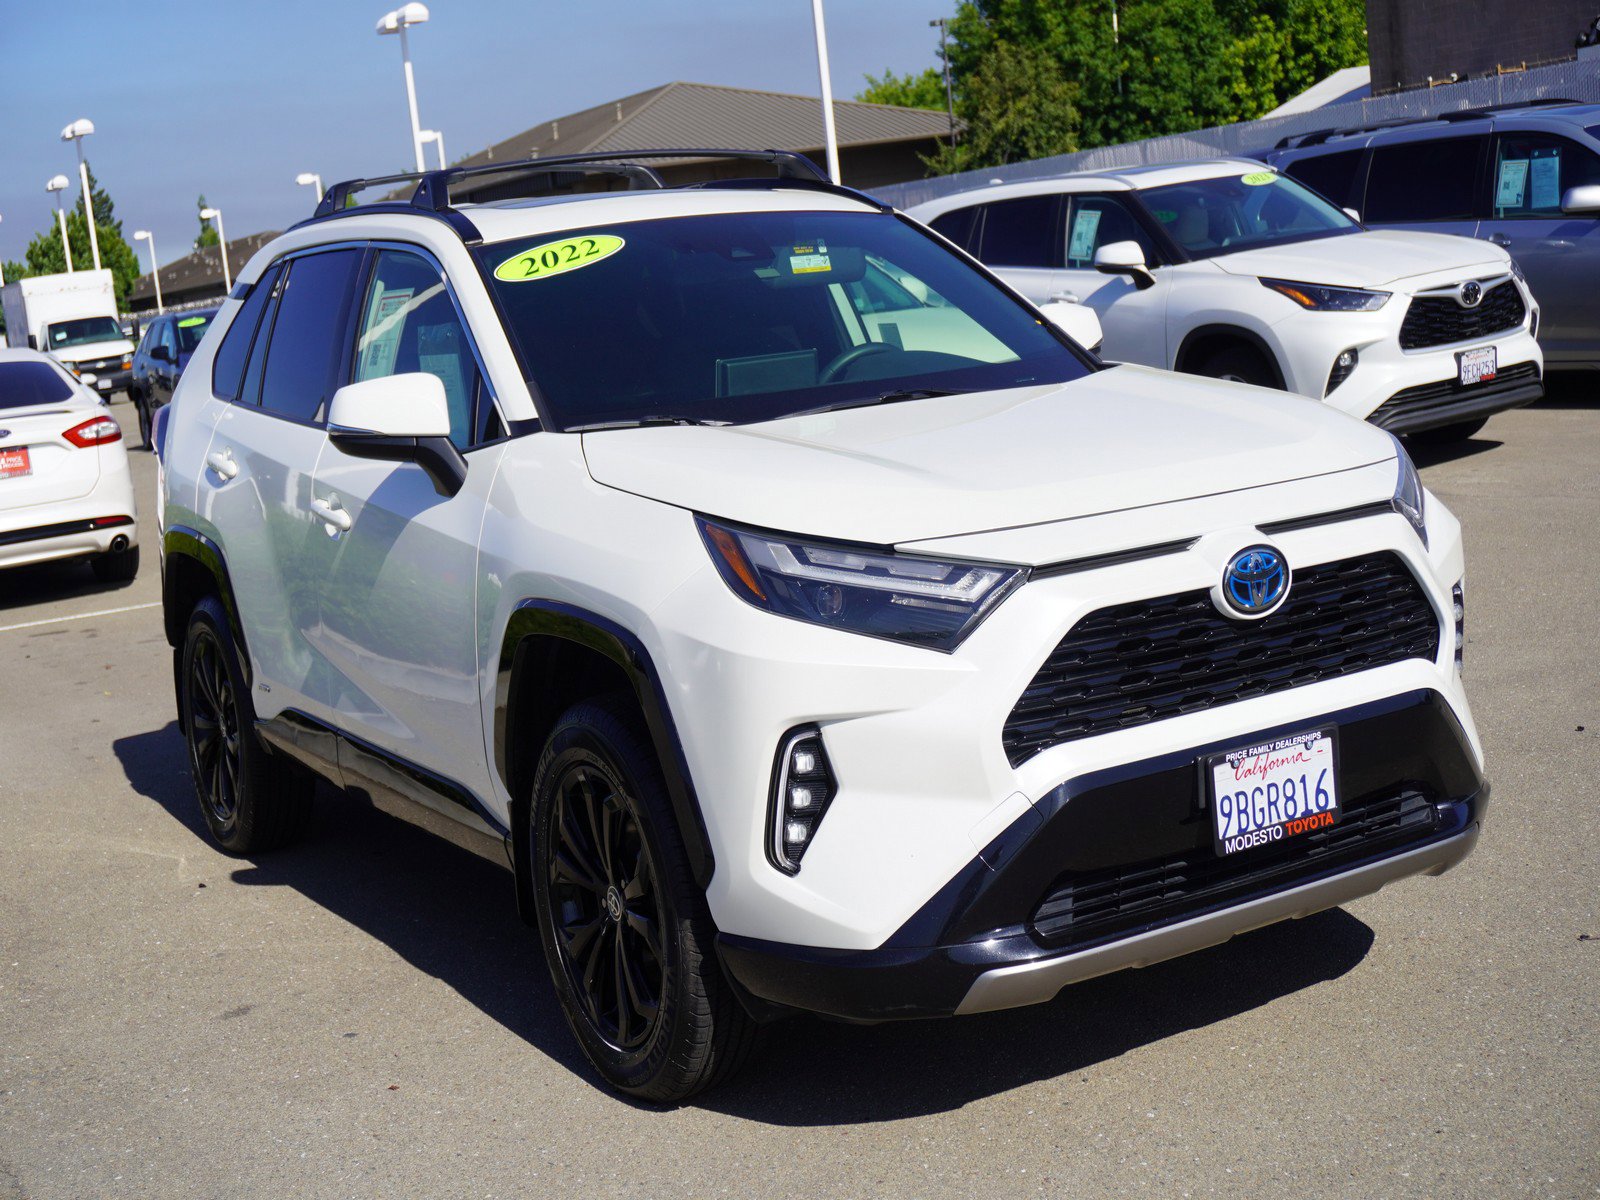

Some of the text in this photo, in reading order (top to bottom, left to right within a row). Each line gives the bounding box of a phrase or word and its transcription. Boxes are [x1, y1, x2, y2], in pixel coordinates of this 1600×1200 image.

[519, 239, 600, 277] 2022
[1225, 731, 1321, 762] PRICE FAMILY DEALERSHIPS
[1235, 752, 1311, 781] California
[1219, 768, 1330, 840] 9BGR816
[1225, 811, 1335, 855] MODESTO TOYOTA
